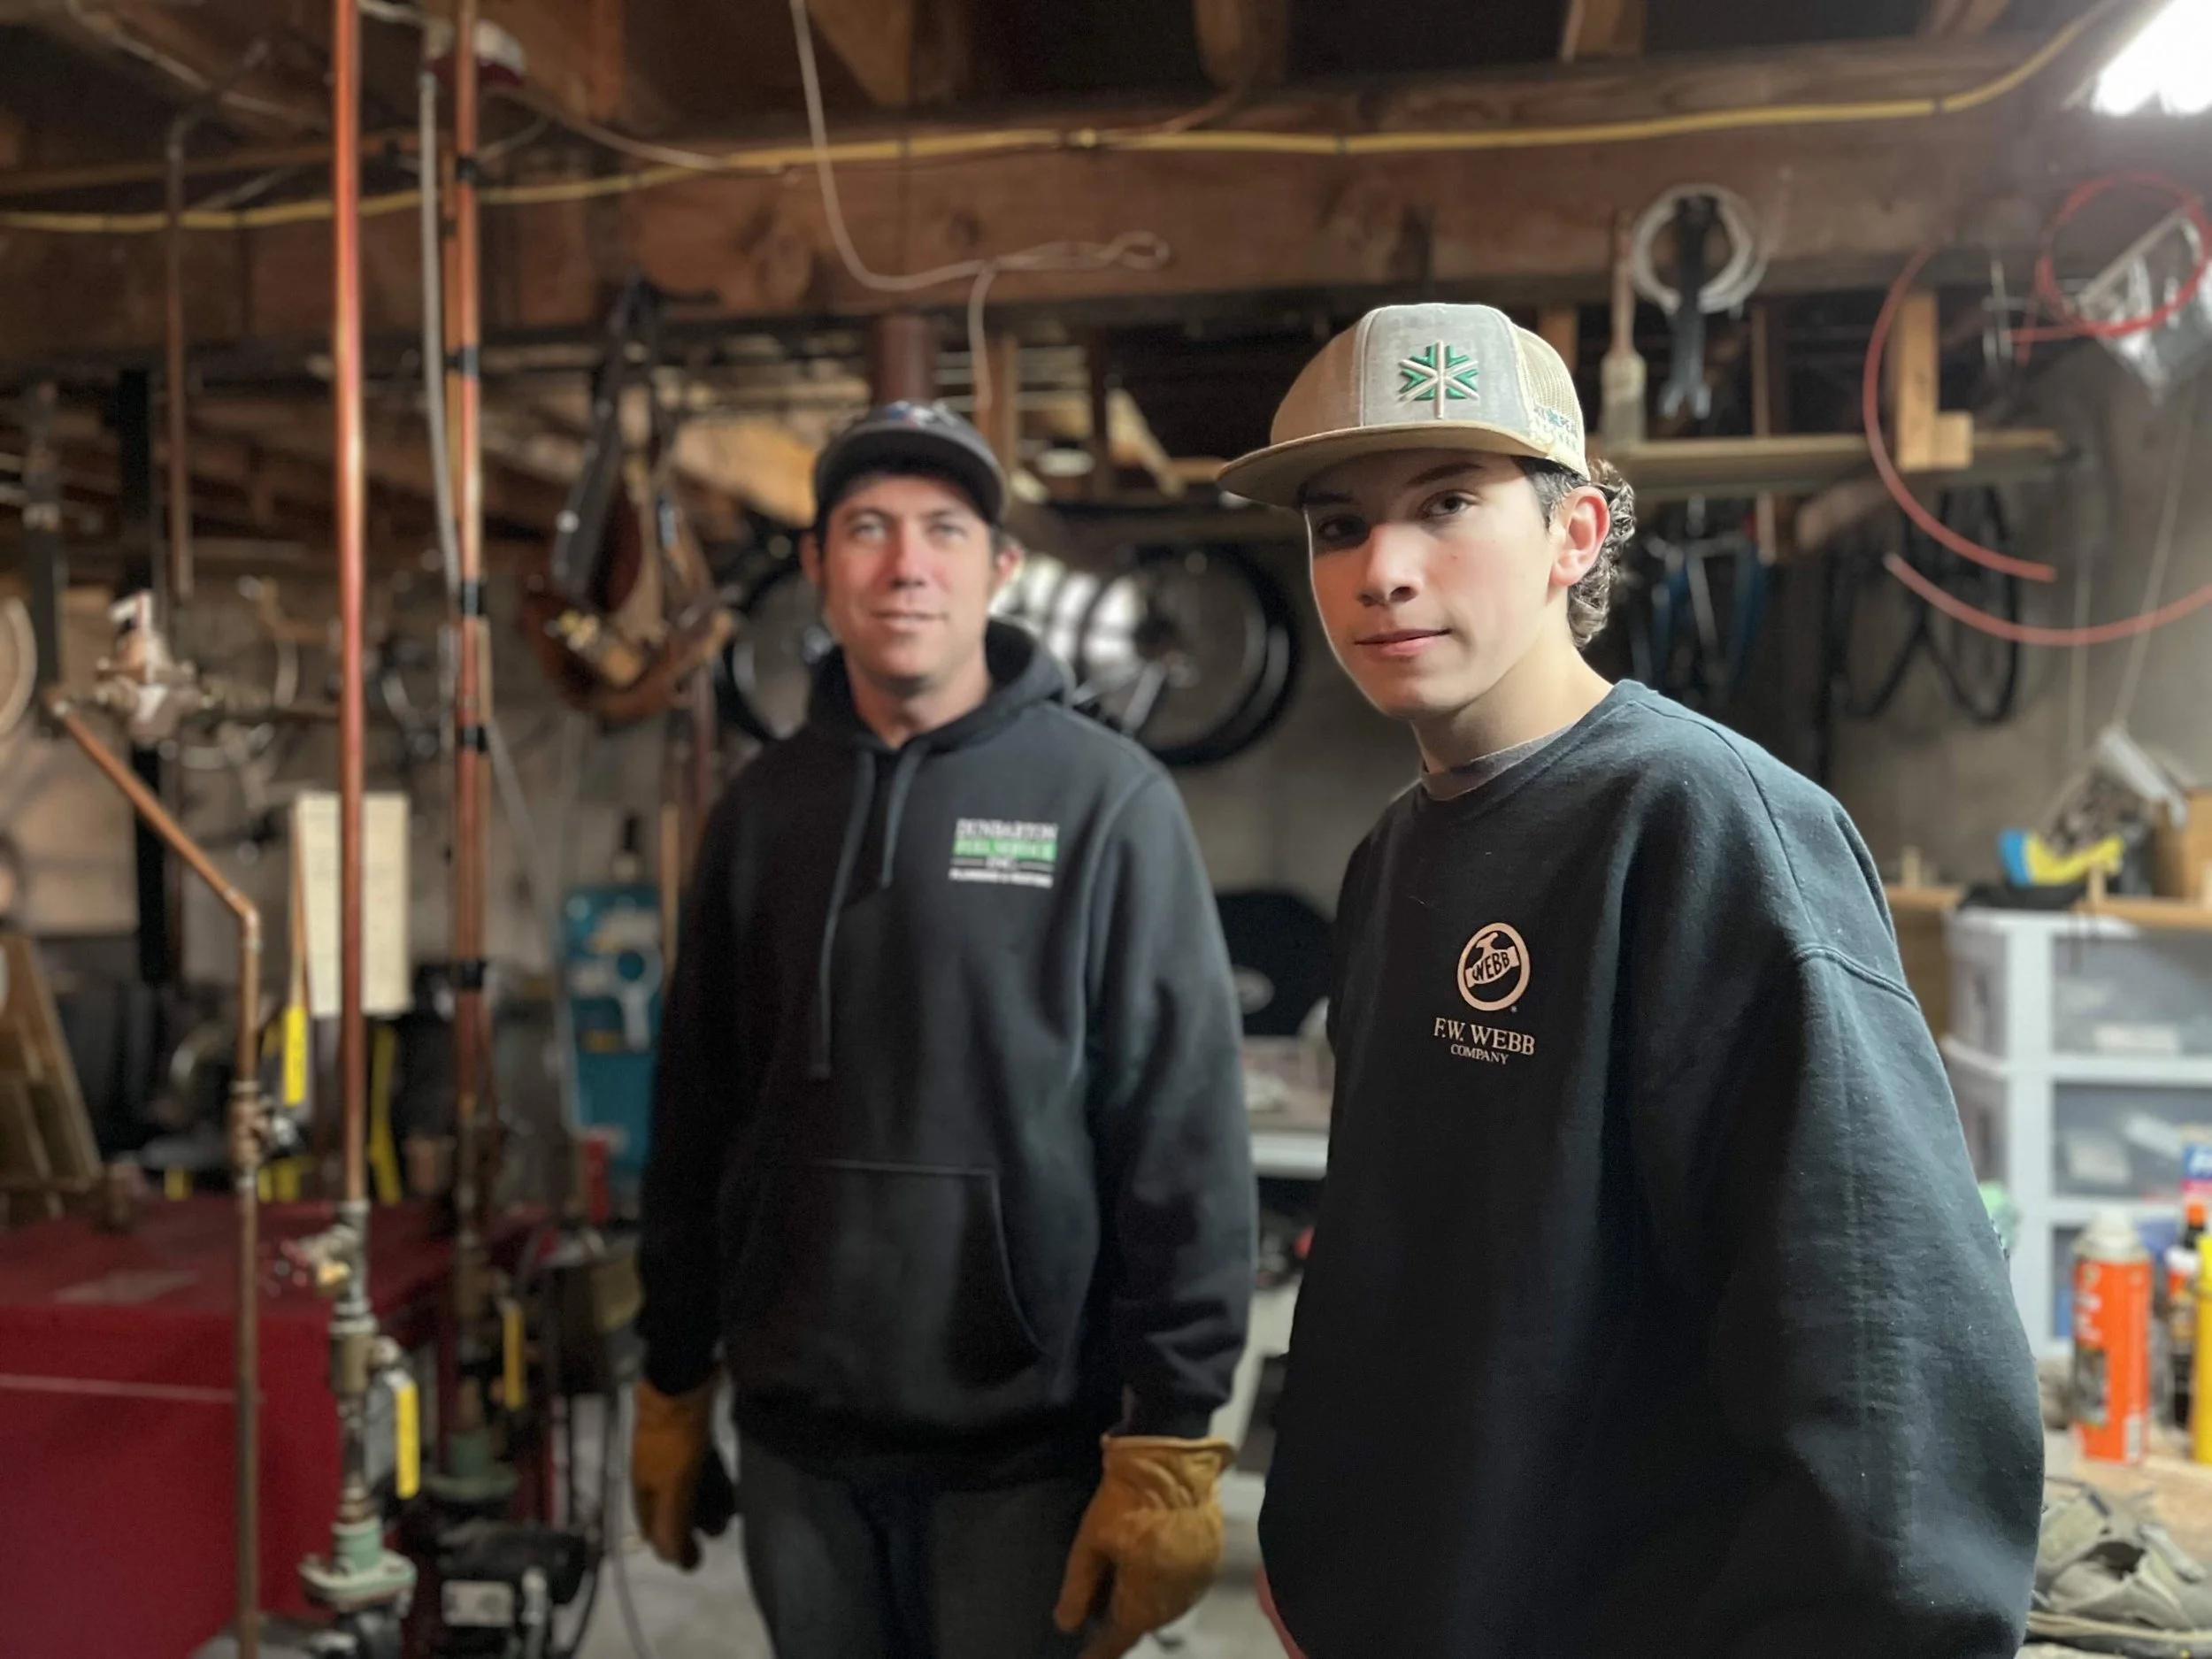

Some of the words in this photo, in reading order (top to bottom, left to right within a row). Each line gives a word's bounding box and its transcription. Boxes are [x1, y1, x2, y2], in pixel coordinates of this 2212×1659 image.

[1472, 951, 1510, 982] WEBB
[1433, 1018, 1466, 1041] F.W.
[1470, 1024, 1536, 1056] WEBB
[1450, 1043, 1509, 1065] COMPANY
